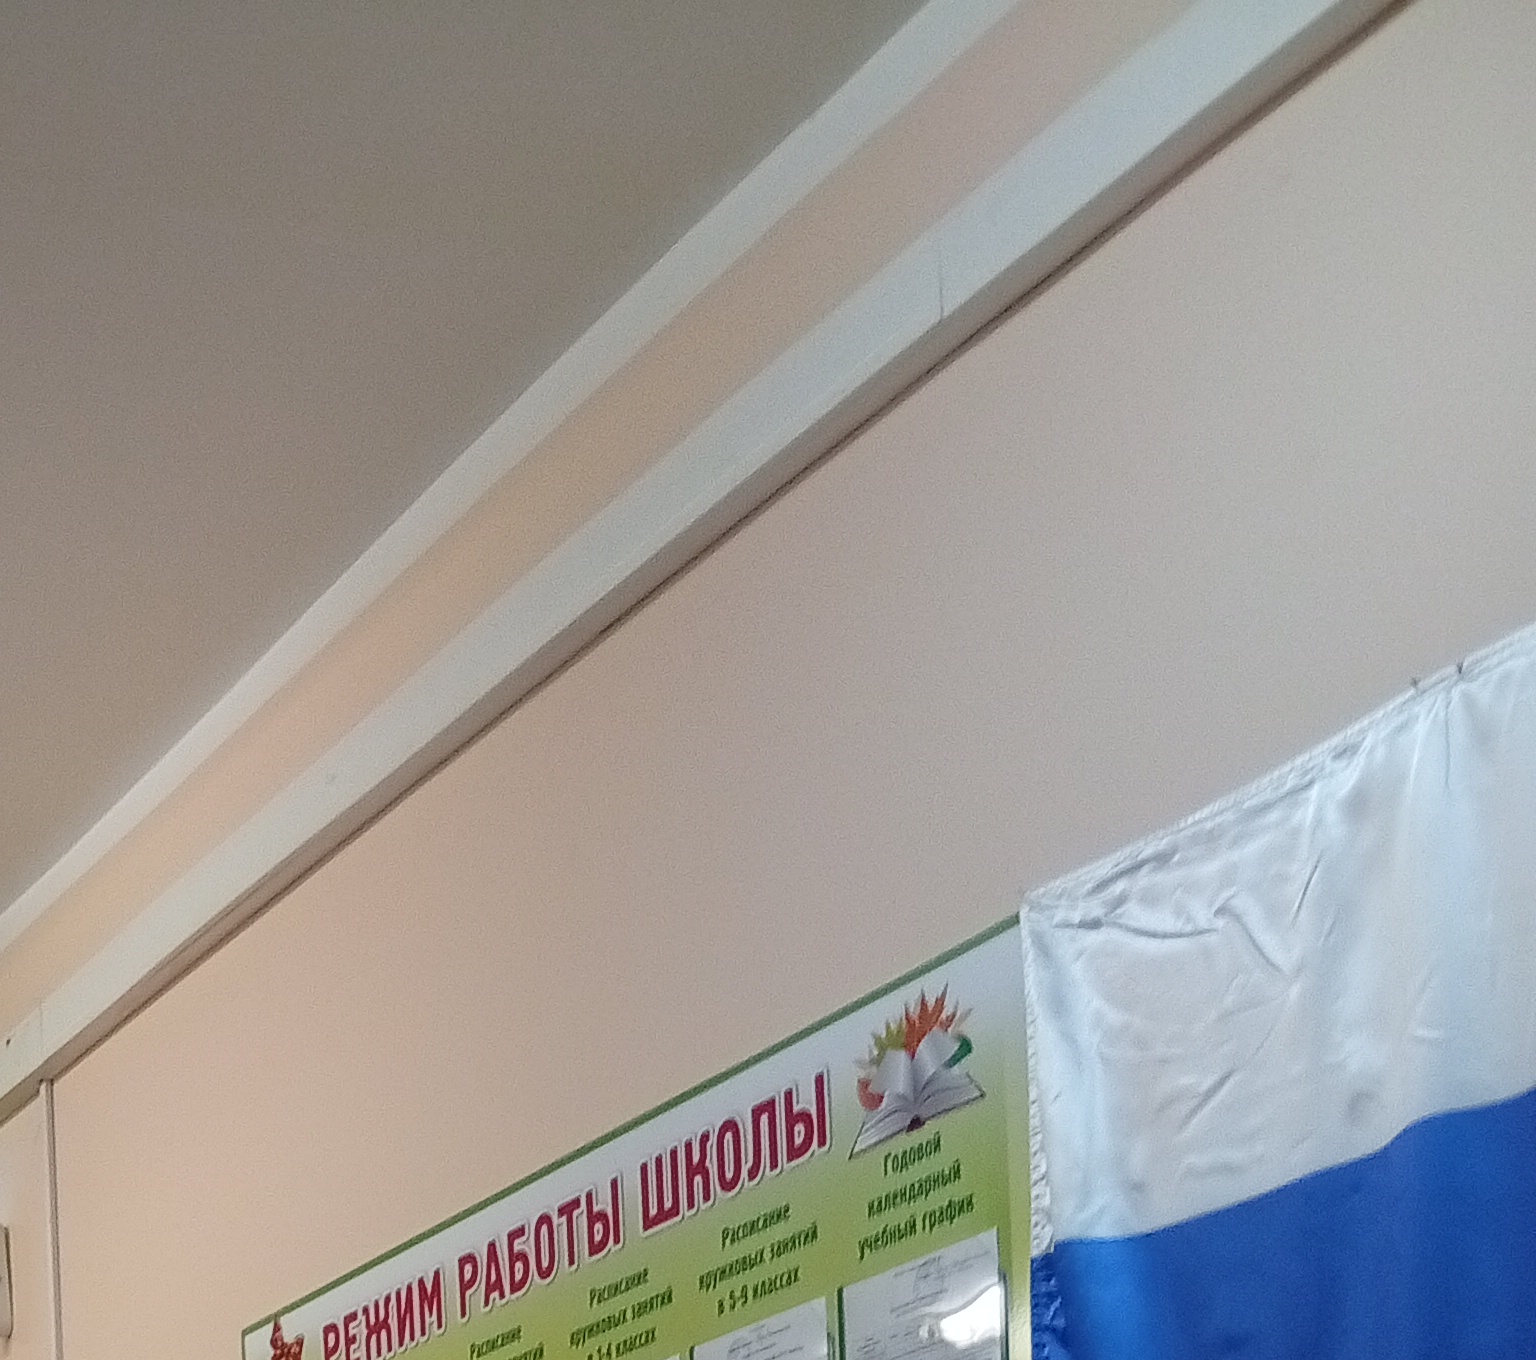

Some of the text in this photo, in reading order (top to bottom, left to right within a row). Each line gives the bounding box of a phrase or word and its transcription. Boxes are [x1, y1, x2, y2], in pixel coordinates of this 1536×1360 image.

[883, 1130, 942, 1177] Годовой
[457, 1177, 622, 1320] РАБОТЫ
[639, 1072, 828, 1233] ШКОЛЫ
[867, 1158, 962, 1219] календарный
[721, 1202, 791, 1250] Расписание
[769, 1220, 819, 1259] занятий
[857, 1192, 975, 1262] учебный график
